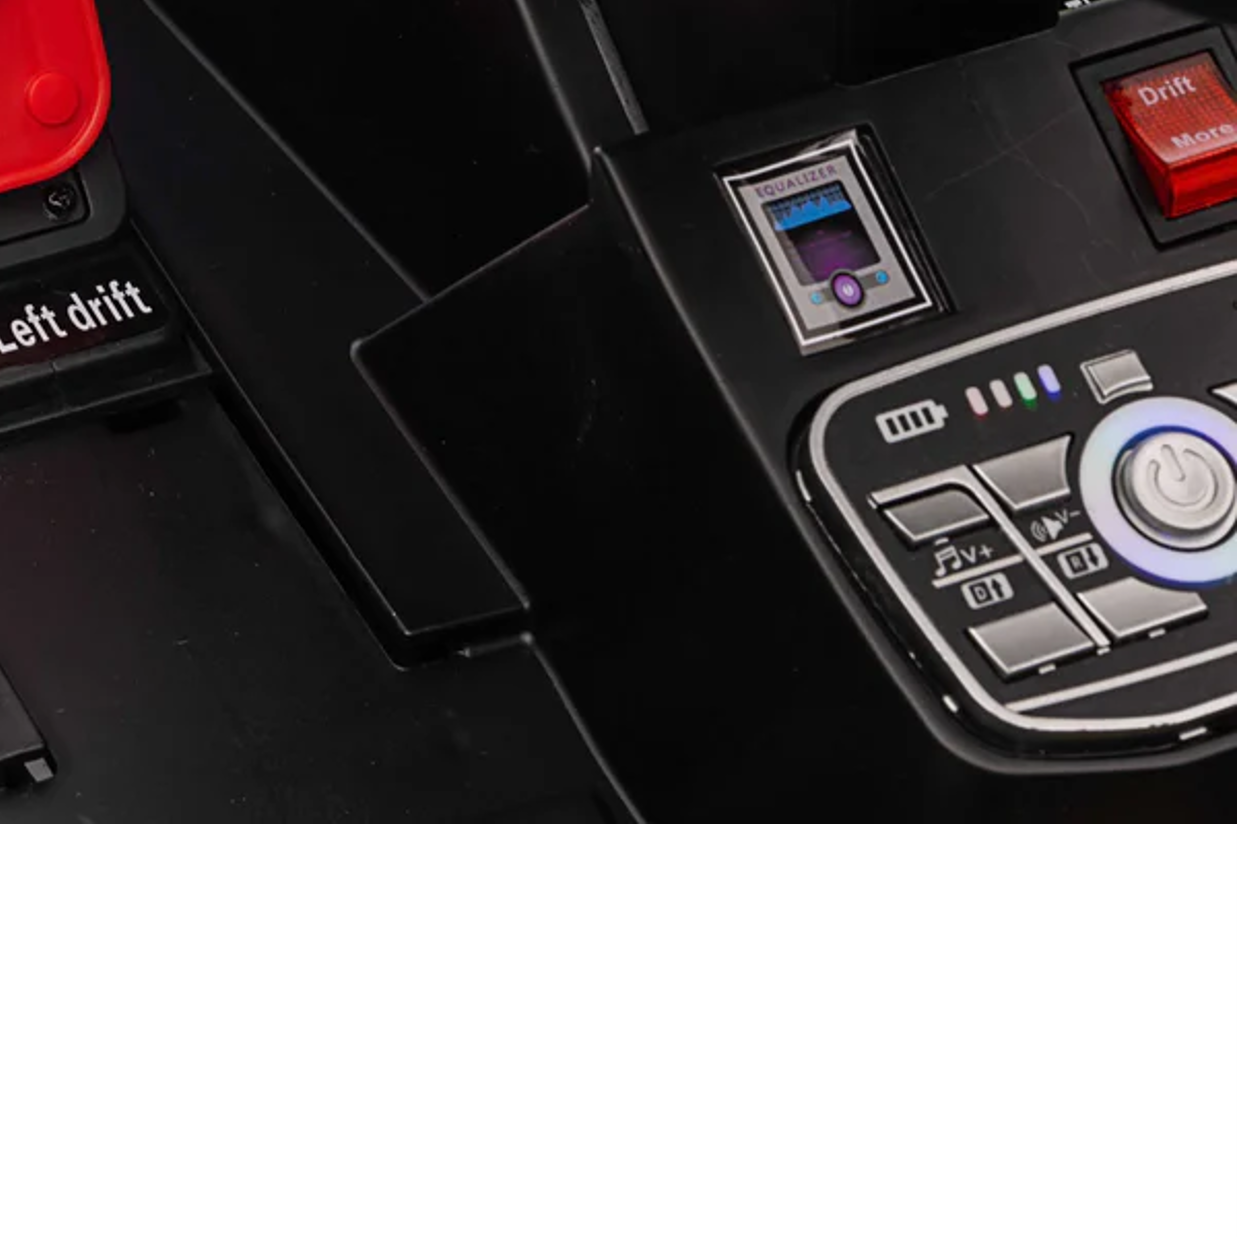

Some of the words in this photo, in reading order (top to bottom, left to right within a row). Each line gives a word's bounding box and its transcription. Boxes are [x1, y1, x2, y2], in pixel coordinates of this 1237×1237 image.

[1137, 75, 1196, 107] Drift
[1170, 124, 1235, 150] More
[755, 164, 838, 199] EQUALIZER
[68, 279, 153, 332] drift
